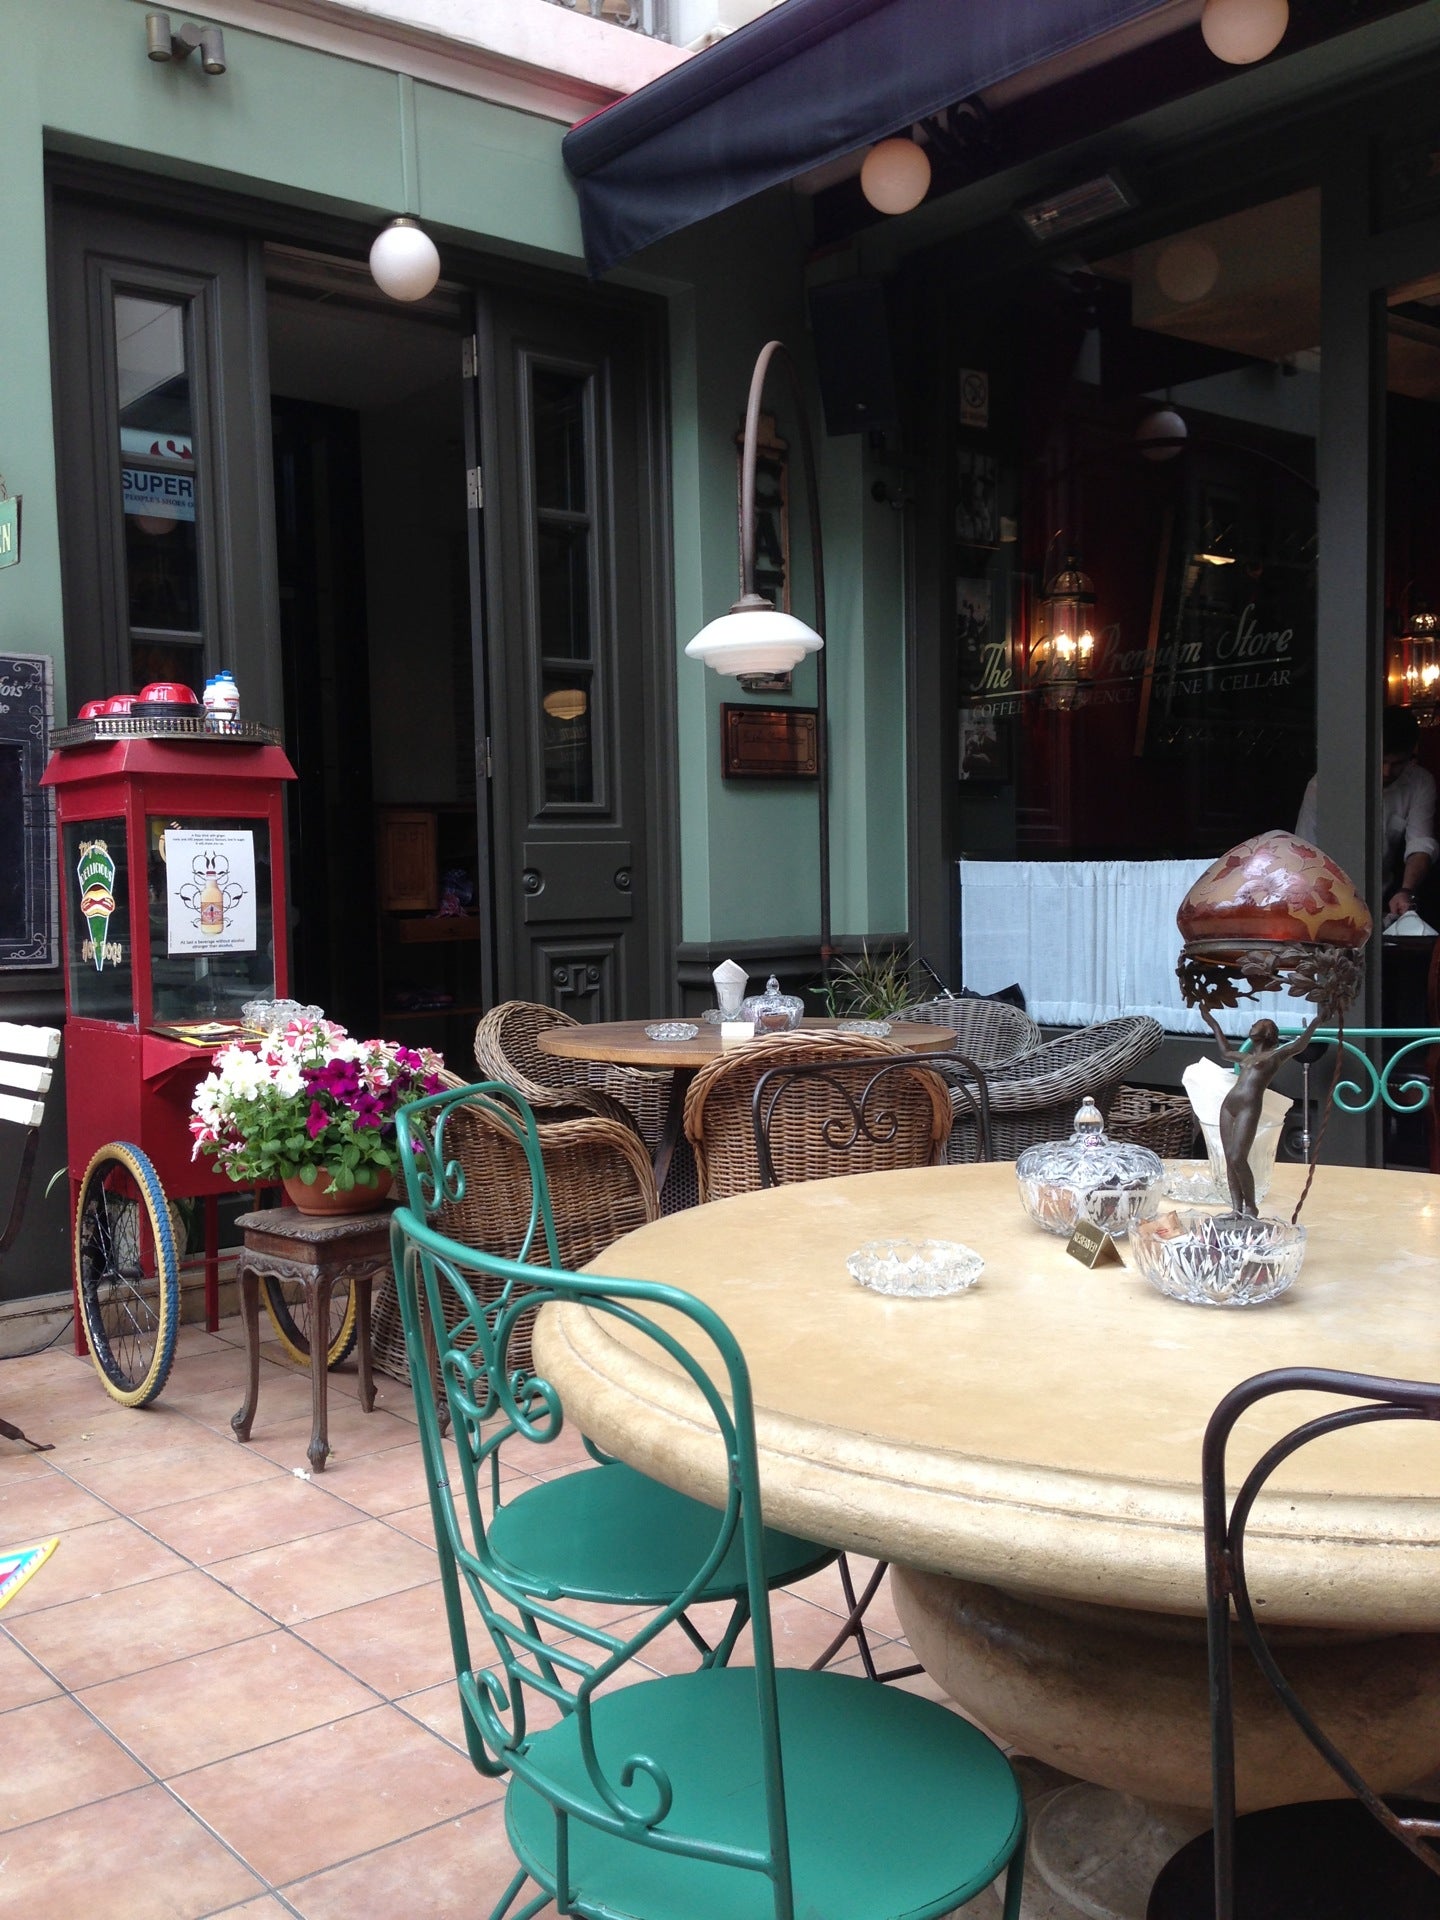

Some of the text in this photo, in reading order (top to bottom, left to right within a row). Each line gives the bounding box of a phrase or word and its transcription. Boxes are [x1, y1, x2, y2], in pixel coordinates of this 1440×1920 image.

[122, 470, 192, 498] SUPER
[969, 639, 1014, 692] The
[1215, 602, 1294, 660] Store
[1155, 678, 1203, 700] WINE
[1218, 669, 1293, 693] CELLAR
[1072, 1231, 1098, 1254] RESERVED
